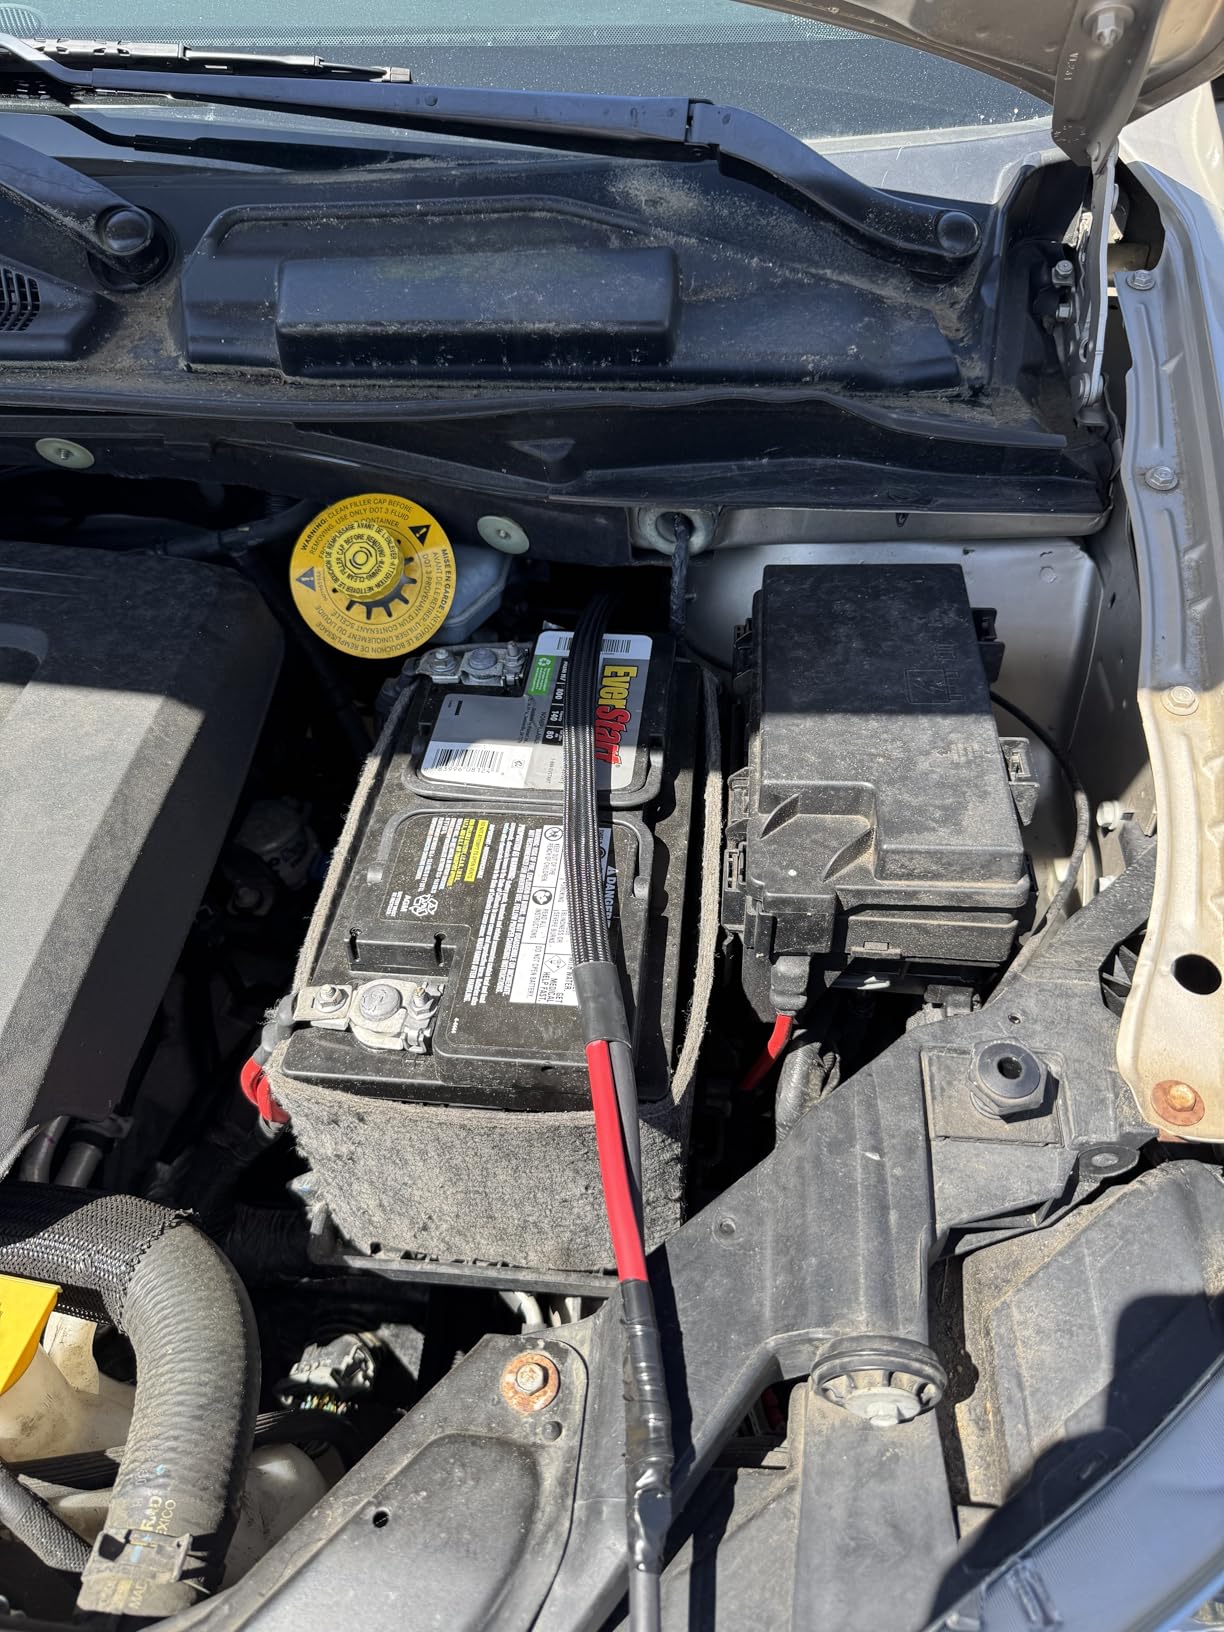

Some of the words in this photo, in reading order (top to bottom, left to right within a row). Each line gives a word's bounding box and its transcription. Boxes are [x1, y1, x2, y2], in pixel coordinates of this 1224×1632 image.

[334, 512, 349, 524] USE
[348, 507, 367, 517] ONLY
[390, 509, 409, 522] FLUID
[301, 516, 328, 551] WARNING:
[327, 504, 349, 519] CLEAN
[348, 498, 371, 508] FILLER
[388, 500, 413, 514] BEFORE
[421, 553, 431, 567] DOT
[432, 550, 442, 573] AVANT
[440, 548, 451, 568] MISE
[436, 576, 442, 586] DE
[445, 570, 451, 581] EN
[412, 576, 432, 615] PROVENANT
[433, 587, 441, 596] LE
[438, 583, 451, 611] GARDE
[335, 625, 347, 636] DU
[354, 623, 398, 634] CONTENANT
[394, 621, 421, 641] UTILISER
[413, 613, 440, 641] NETTOYER
[315, 620, 359, 649] REMPLISSAGE
[346, 632, 394, 644] UNIQUEMENT
[371, 641, 406, 654] BOUCHON
[405, 637, 414, 646] LE
[554, 688, 564, 699] 800
[550, 710, 559, 721] 140
[596, 664, 638, 765] EverStart
[545, 730, 554, 738] 80
[400, 894, 411, 911] AGM
[529, 964, 539, 975] OPEN
[540, 971, 550, 984] HELP
[537, 987, 548, 1001] FAST.
[546, 978, 557, 1002] MEDICAL
[554, 992, 563, 1002] GET
